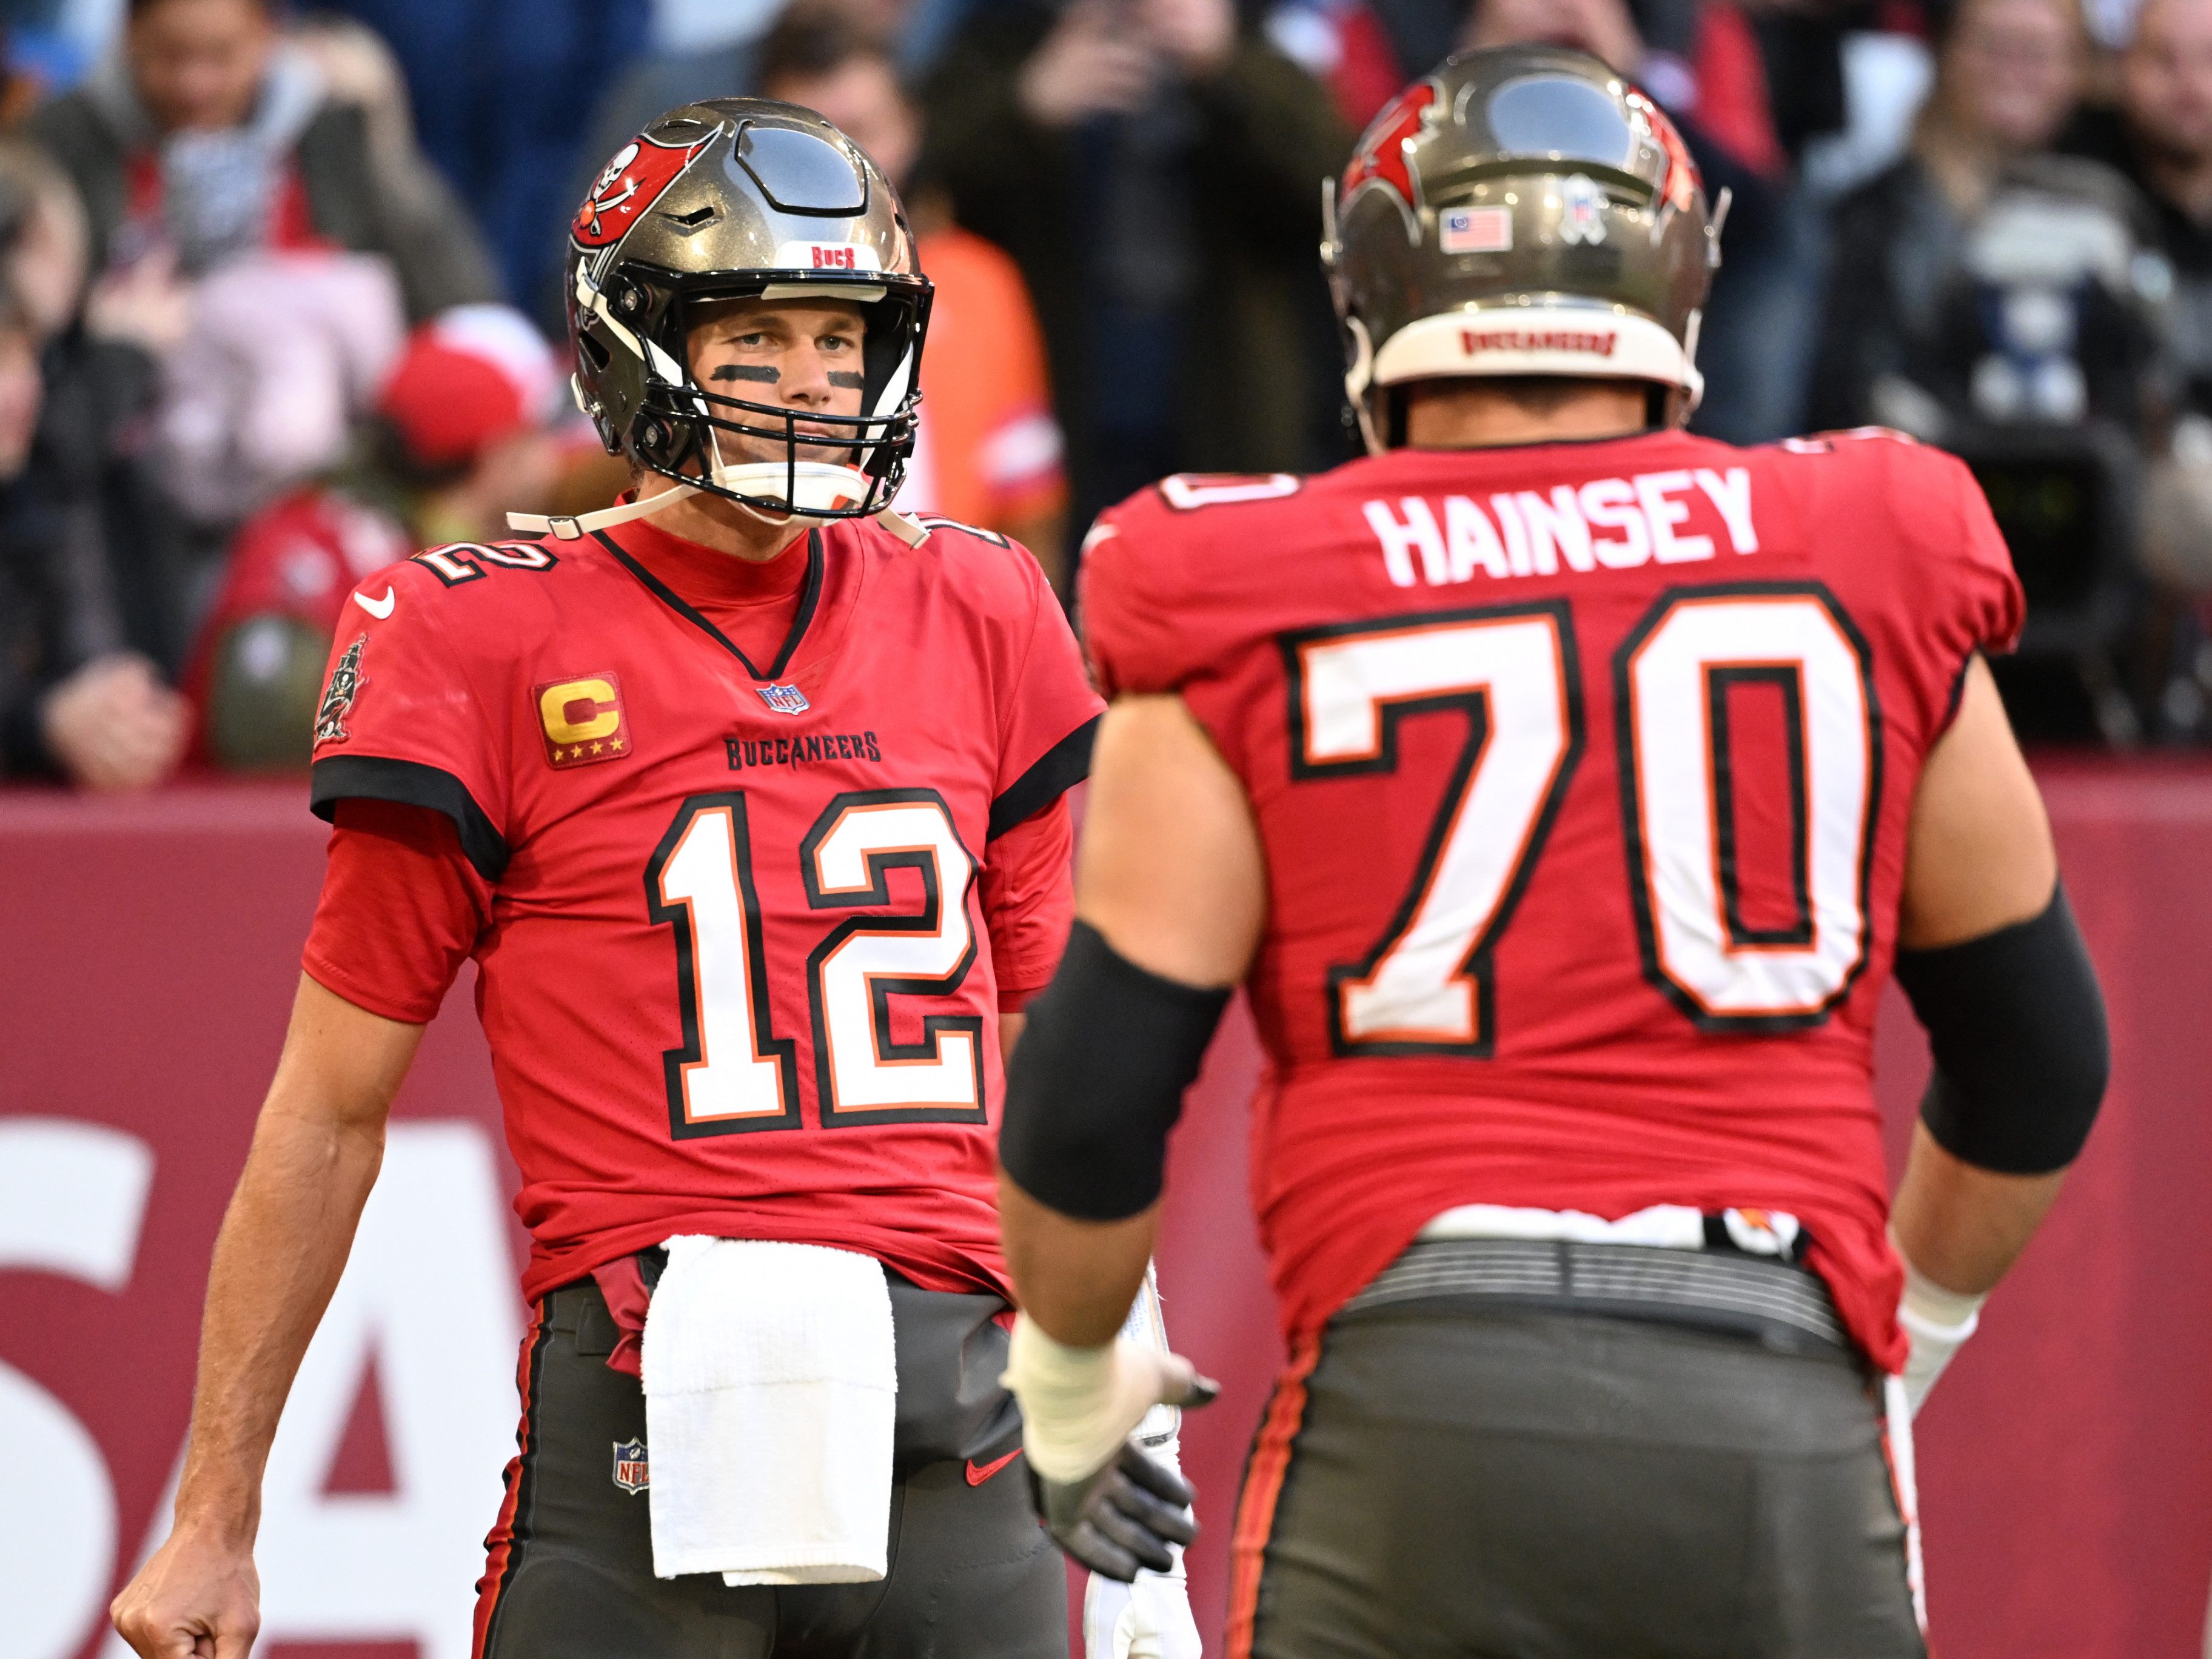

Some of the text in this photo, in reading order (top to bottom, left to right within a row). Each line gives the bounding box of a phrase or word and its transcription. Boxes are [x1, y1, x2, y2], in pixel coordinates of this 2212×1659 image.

[1362, 467, 1759, 587] HAINSEY
[540, 679, 620, 745] C
[771, 695, 802, 708] NFL
[724, 731, 881, 771] BUCCANEERS
[1279, 580, 1883, 1057] 70
[643, 787, 988, 1141] 12
[620, 1463, 649, 1485] NFL
